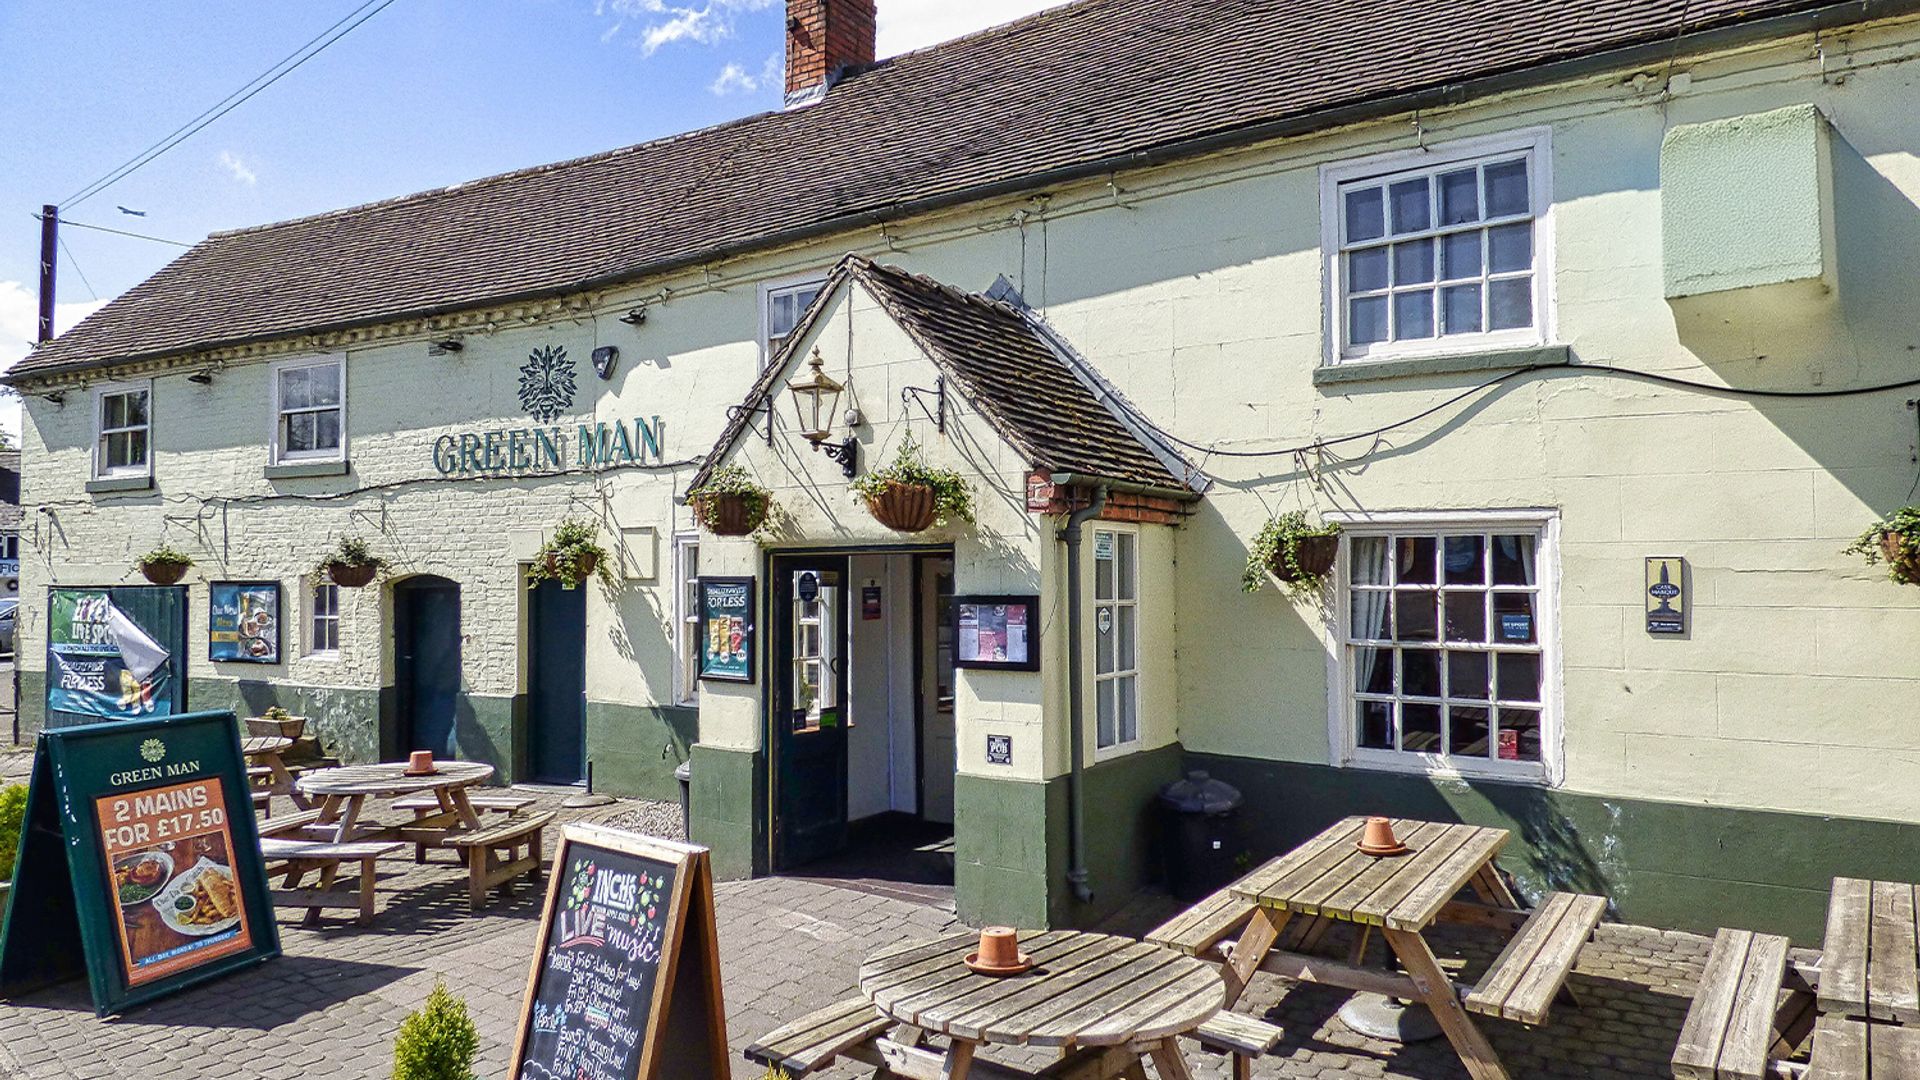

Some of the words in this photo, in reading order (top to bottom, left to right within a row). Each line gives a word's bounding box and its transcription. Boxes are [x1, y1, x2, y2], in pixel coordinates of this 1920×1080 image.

[433, 427, 561, 474] GREEN
[577, 415, 660, 466] MAN
[707, 596, 721, 608] FOR
[723, 596, 745, 607] LESS
[72, 622, 90, 640] LIVE
[78, 676, 105, 691] LESS
[111, 766, 162, 785] GREEN
[167, 760, 200, 777] MAN
[114, 800, 130, 822] 2
[135, 786, 207, 818] MAINS
[104, 823, 150, 850] FOR
[157, 808, 224, 837] £17.50
[561, 906, 606, 942] LIVE
